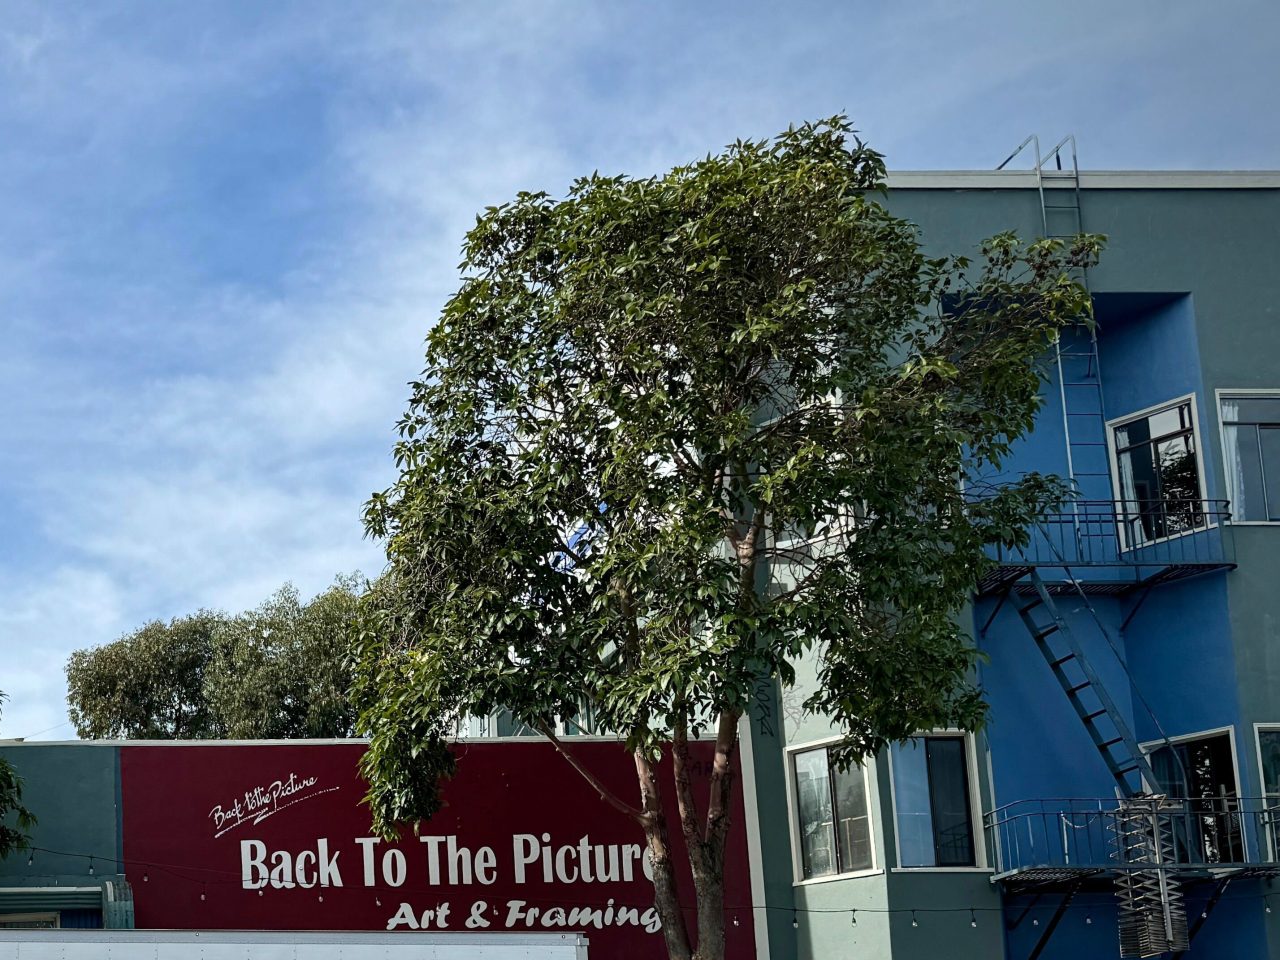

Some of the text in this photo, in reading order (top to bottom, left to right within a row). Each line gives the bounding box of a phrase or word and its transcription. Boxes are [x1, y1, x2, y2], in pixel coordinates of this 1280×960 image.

[208, 799, 245, 829] Back
[268, 772, 319, 811] Picture
[240, 838, 344, 889] Back
[355, 837, 407, 888] To
[420, 835, 498, 886] The
[386, 899, 663, 934] Art & Framing
